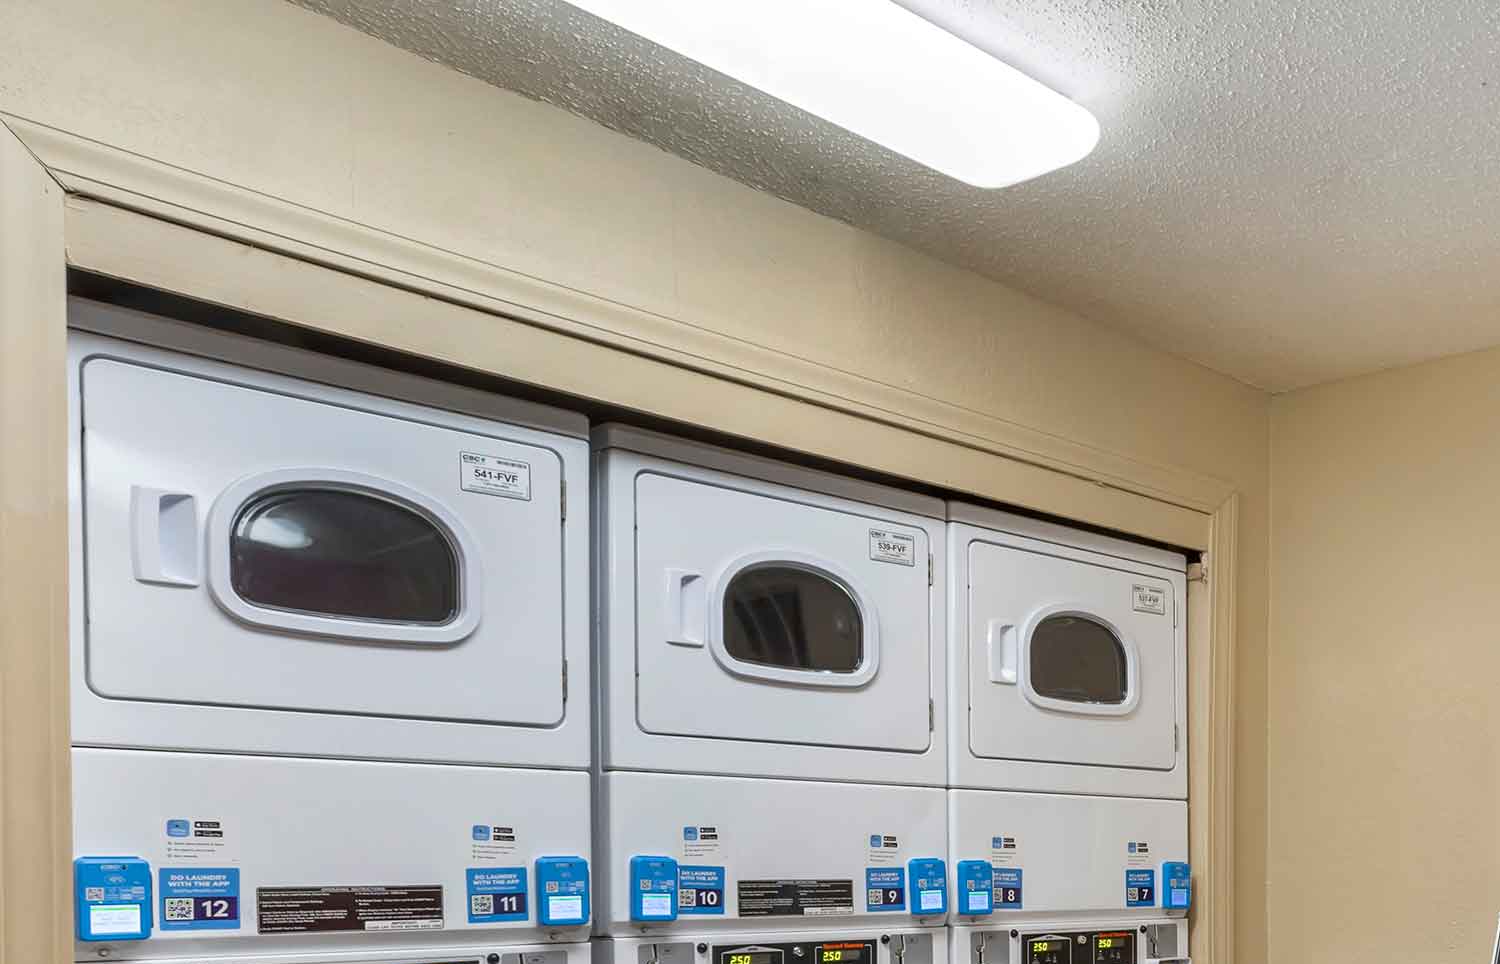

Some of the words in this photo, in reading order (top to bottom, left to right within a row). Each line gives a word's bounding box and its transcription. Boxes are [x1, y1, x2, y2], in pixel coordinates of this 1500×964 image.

[474, 468, 519, 483] 541-FVF
[699, 891, 717, 905] 10
[889, 890, 897, 903] 9
[1007, 890, 1015, 902] 8
[1142, 889, 1149, 900] 7
[201, 900, 229, 918] 12
[500, 896, 517, 911] 11
